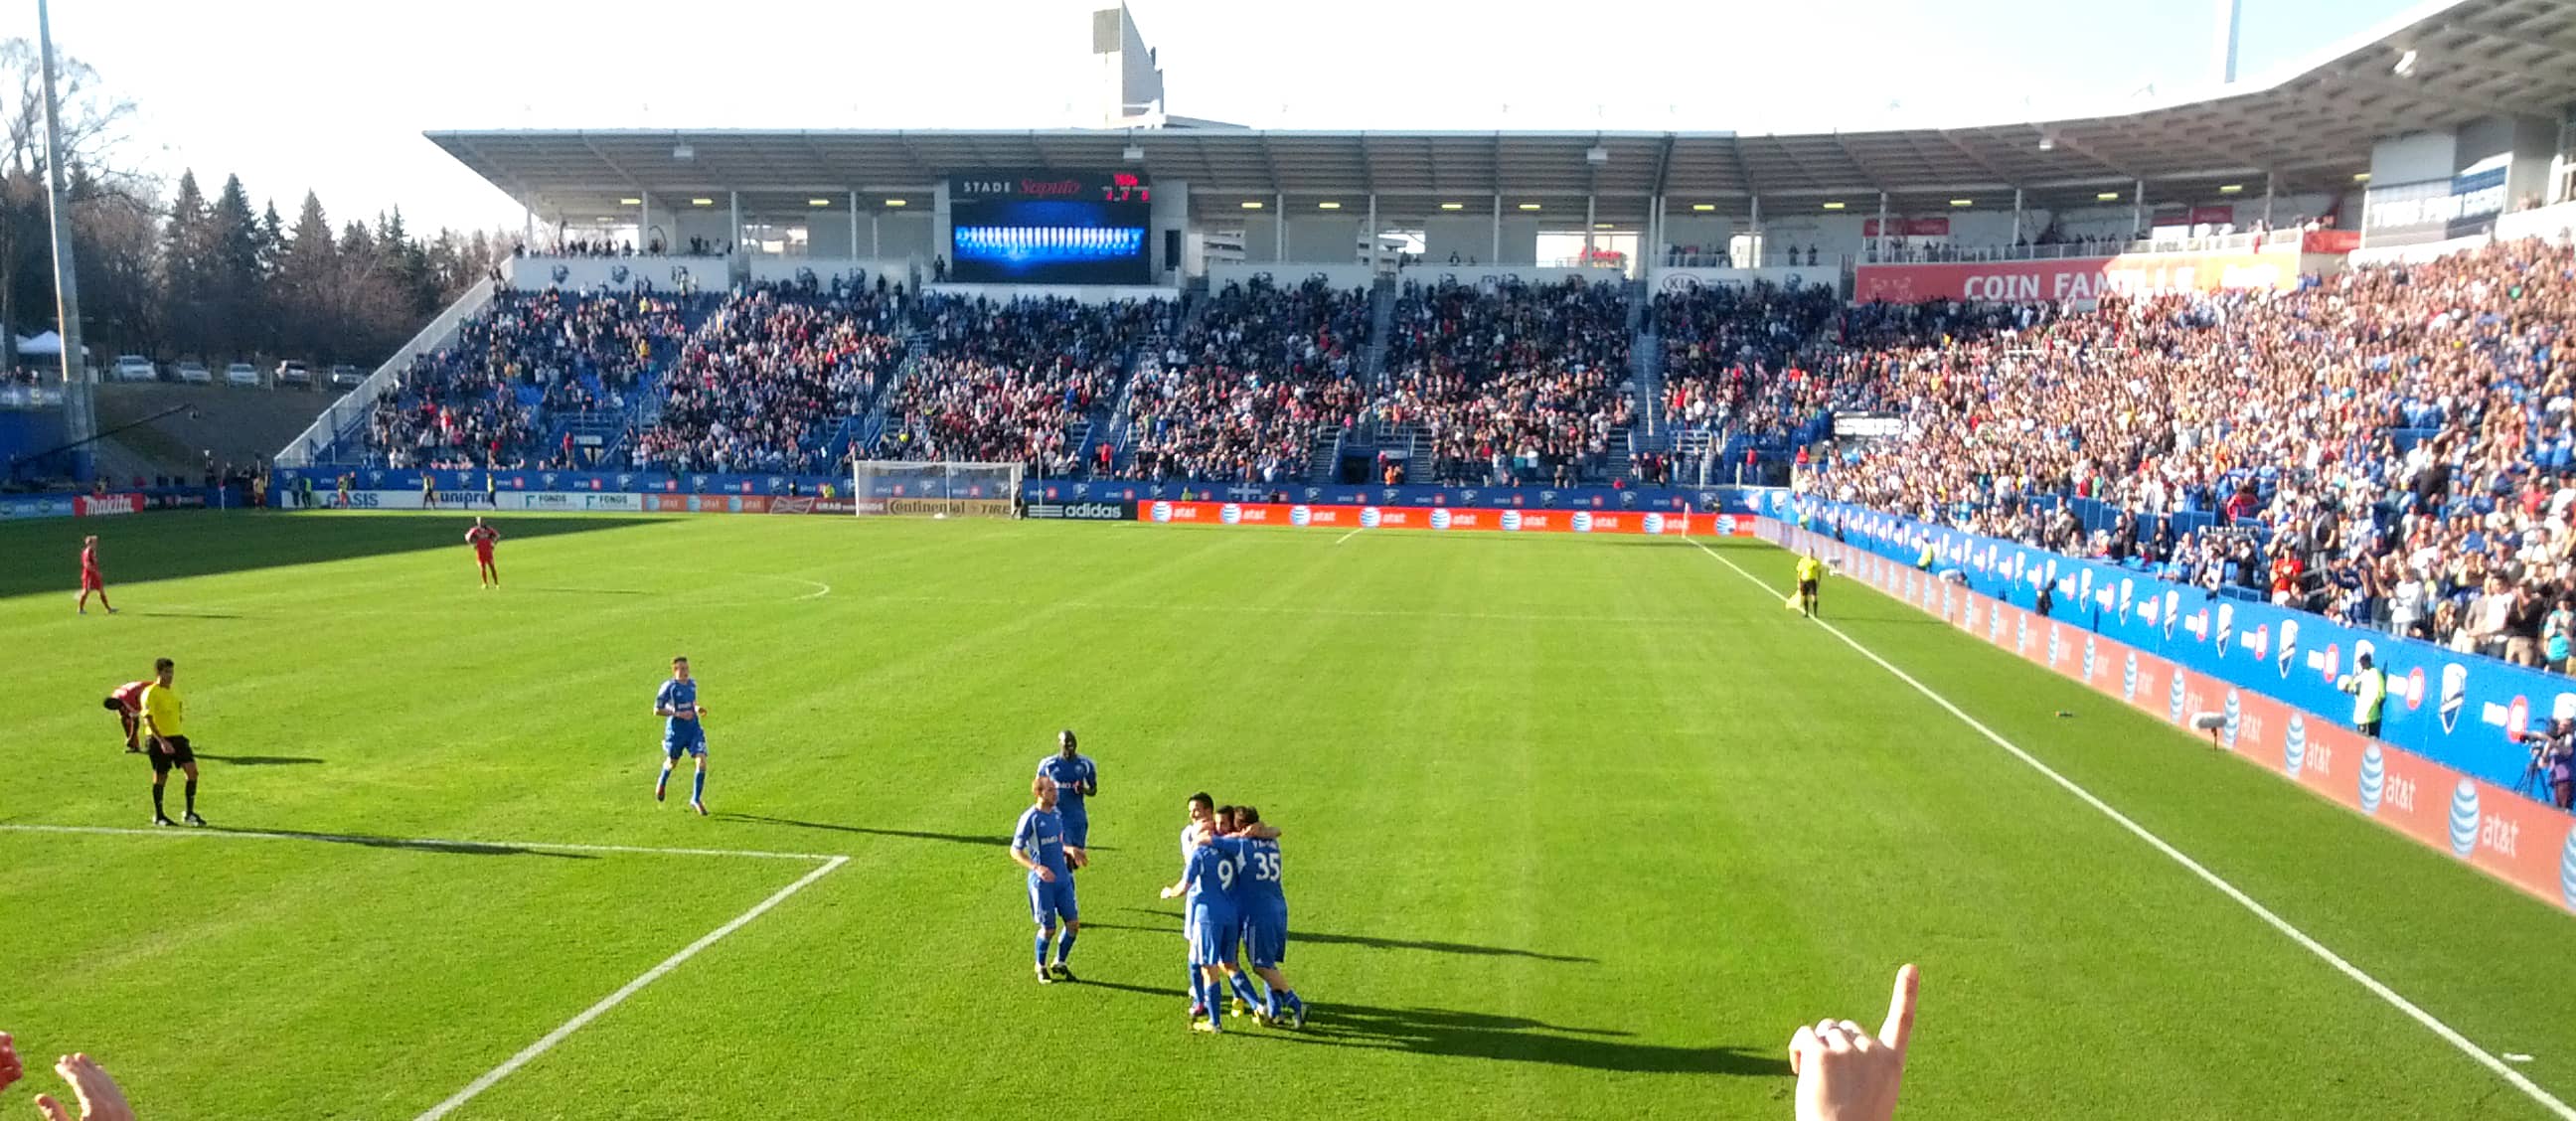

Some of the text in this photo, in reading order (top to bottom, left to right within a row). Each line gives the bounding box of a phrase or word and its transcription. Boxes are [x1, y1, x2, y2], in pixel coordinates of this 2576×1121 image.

[964, 181, 1011, 194] STADE
[1964, 273, 2040, 301] COIN
[326, 492, 380, 507] OSIS
[440, 492, 494, 510] unipri
[1064, 503, 1122, 519] adidas
[1216, 861, 1233, 890] 9
[1253, 852, 1281, 882] 35
